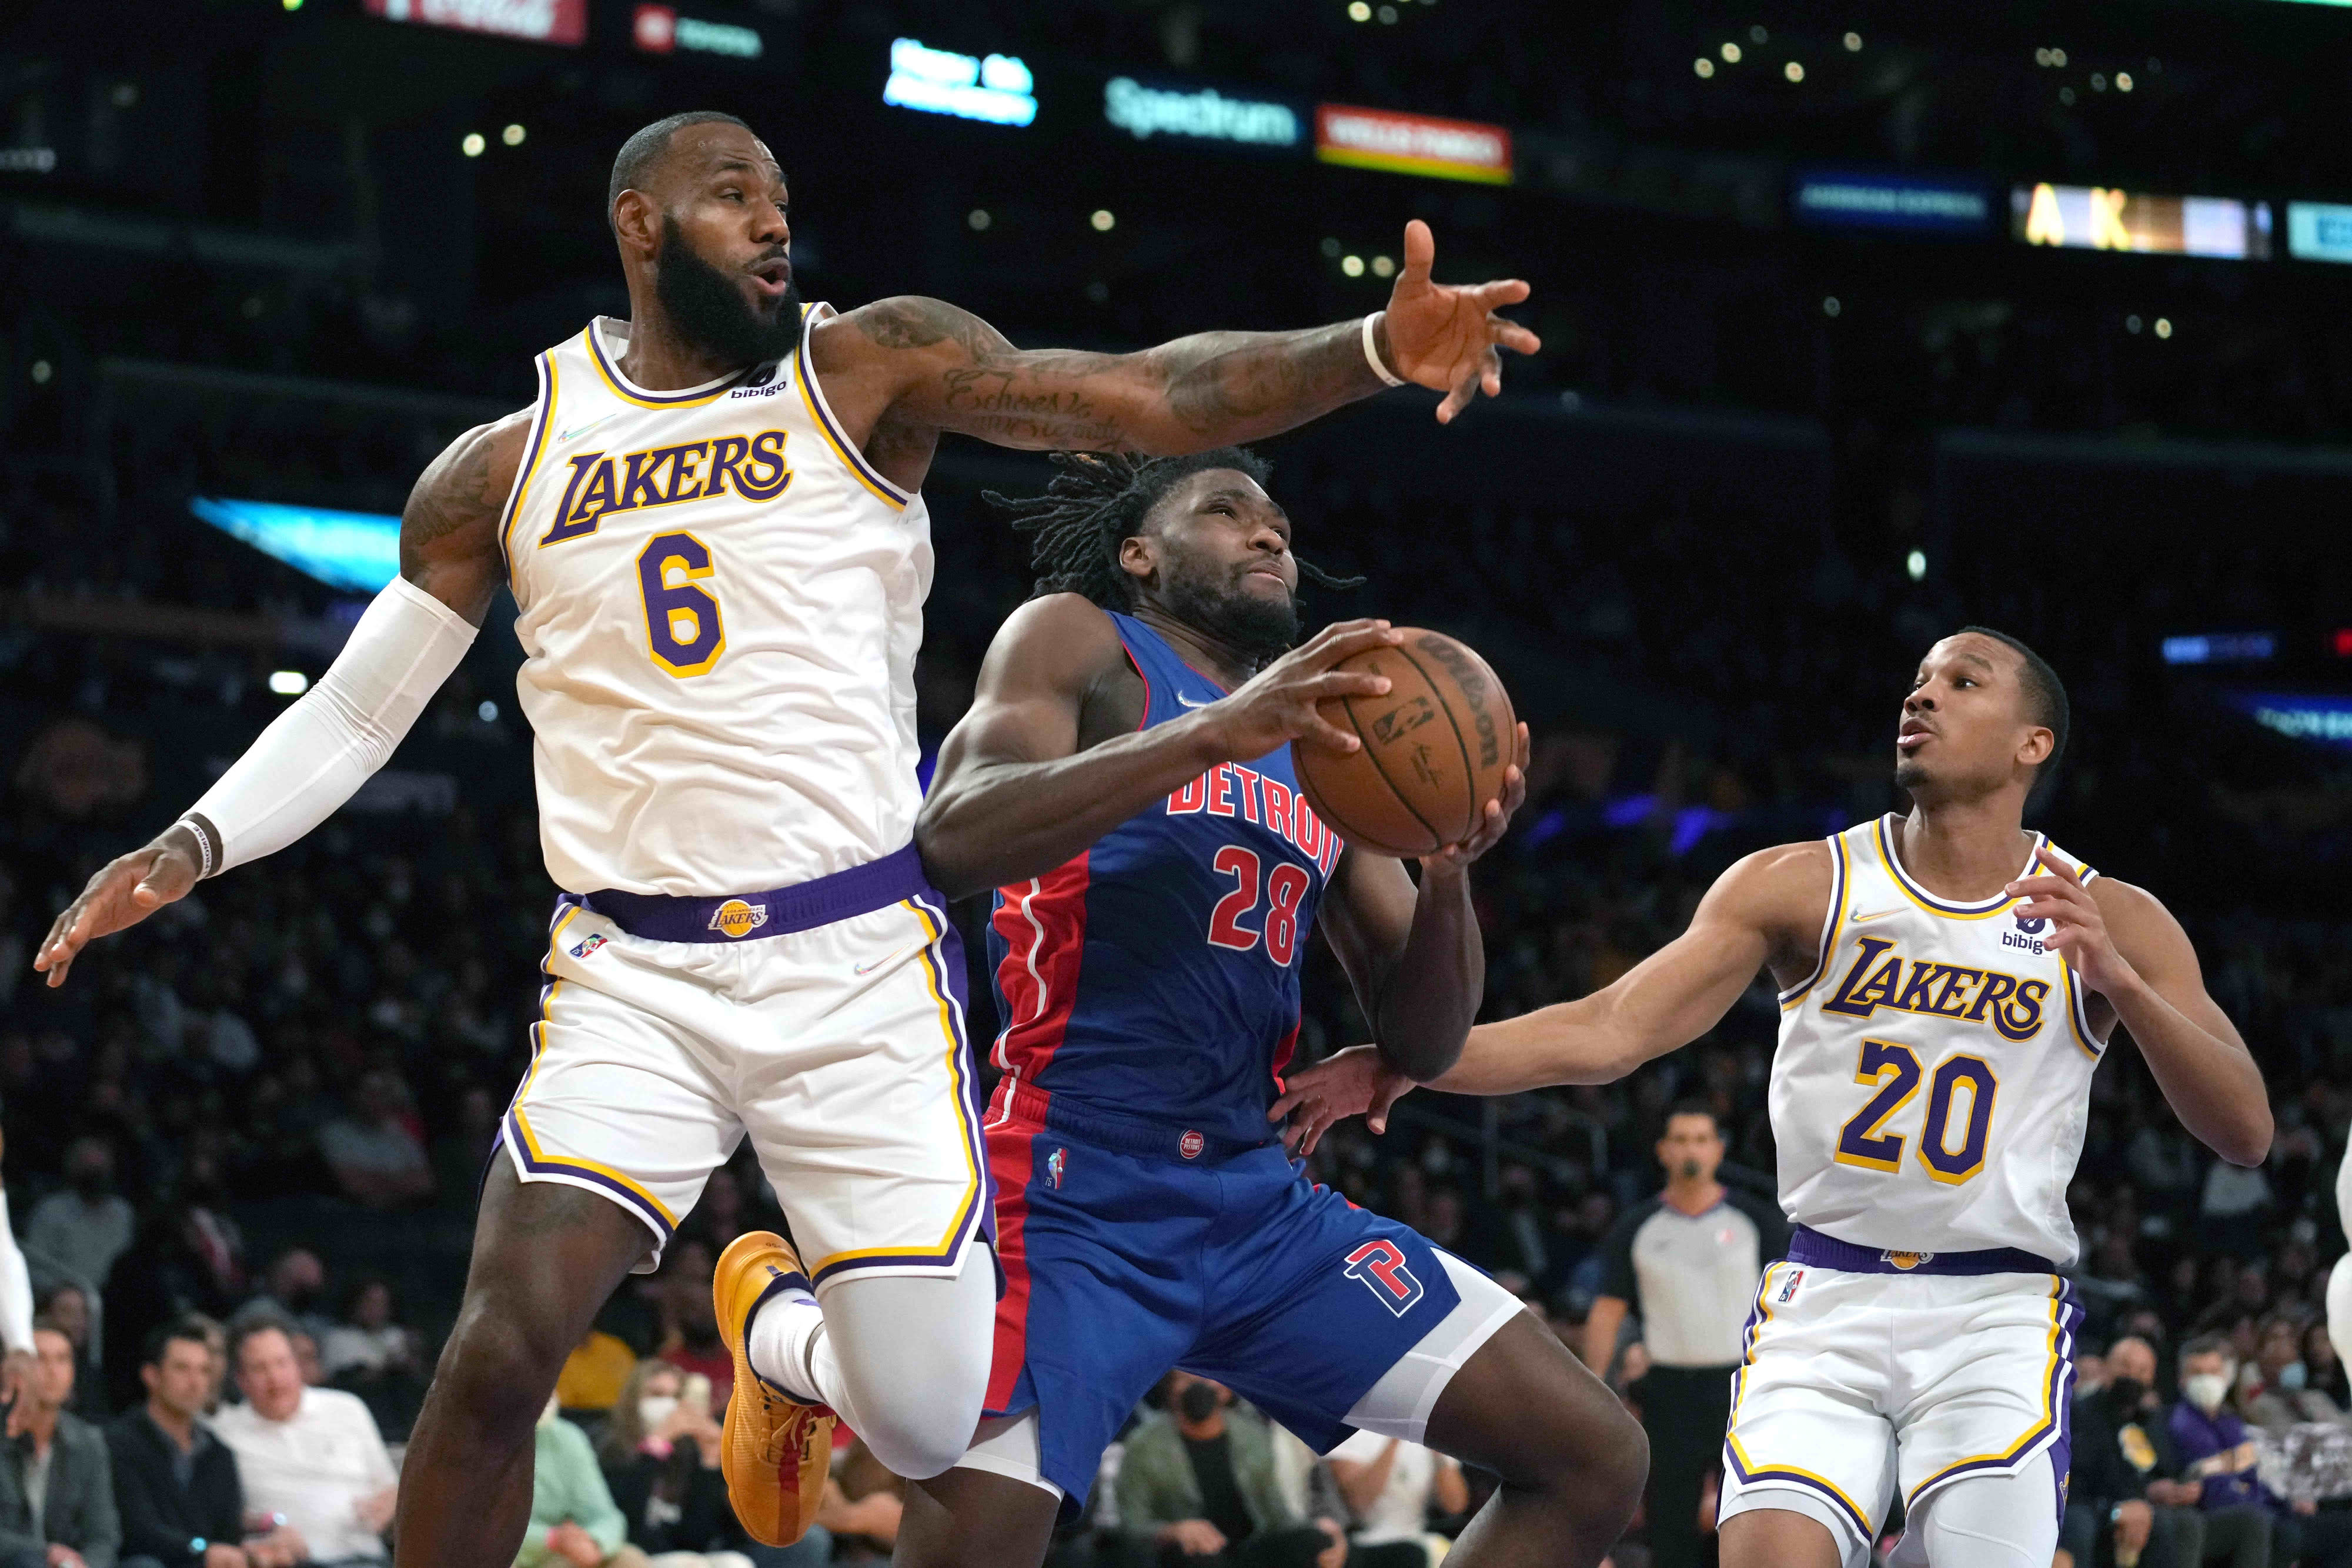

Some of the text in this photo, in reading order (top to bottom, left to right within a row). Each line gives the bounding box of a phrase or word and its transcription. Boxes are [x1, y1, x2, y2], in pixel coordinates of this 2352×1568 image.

[731, 381, 787, 397] bibigo
[538, 430, 794, 549] LAKERS
[635, 529, 727, 679] 6
[709, 910, 766, 928] LAKERS
[1207, 845, 1310, 967] 28
[2002, 932, 2044, 955] bibig
[1820, 935, 2053, 1043] LAKERS
[1833, 1037, 1999, 1186] 20
[1045, 1176, 1053, 1186] 75
